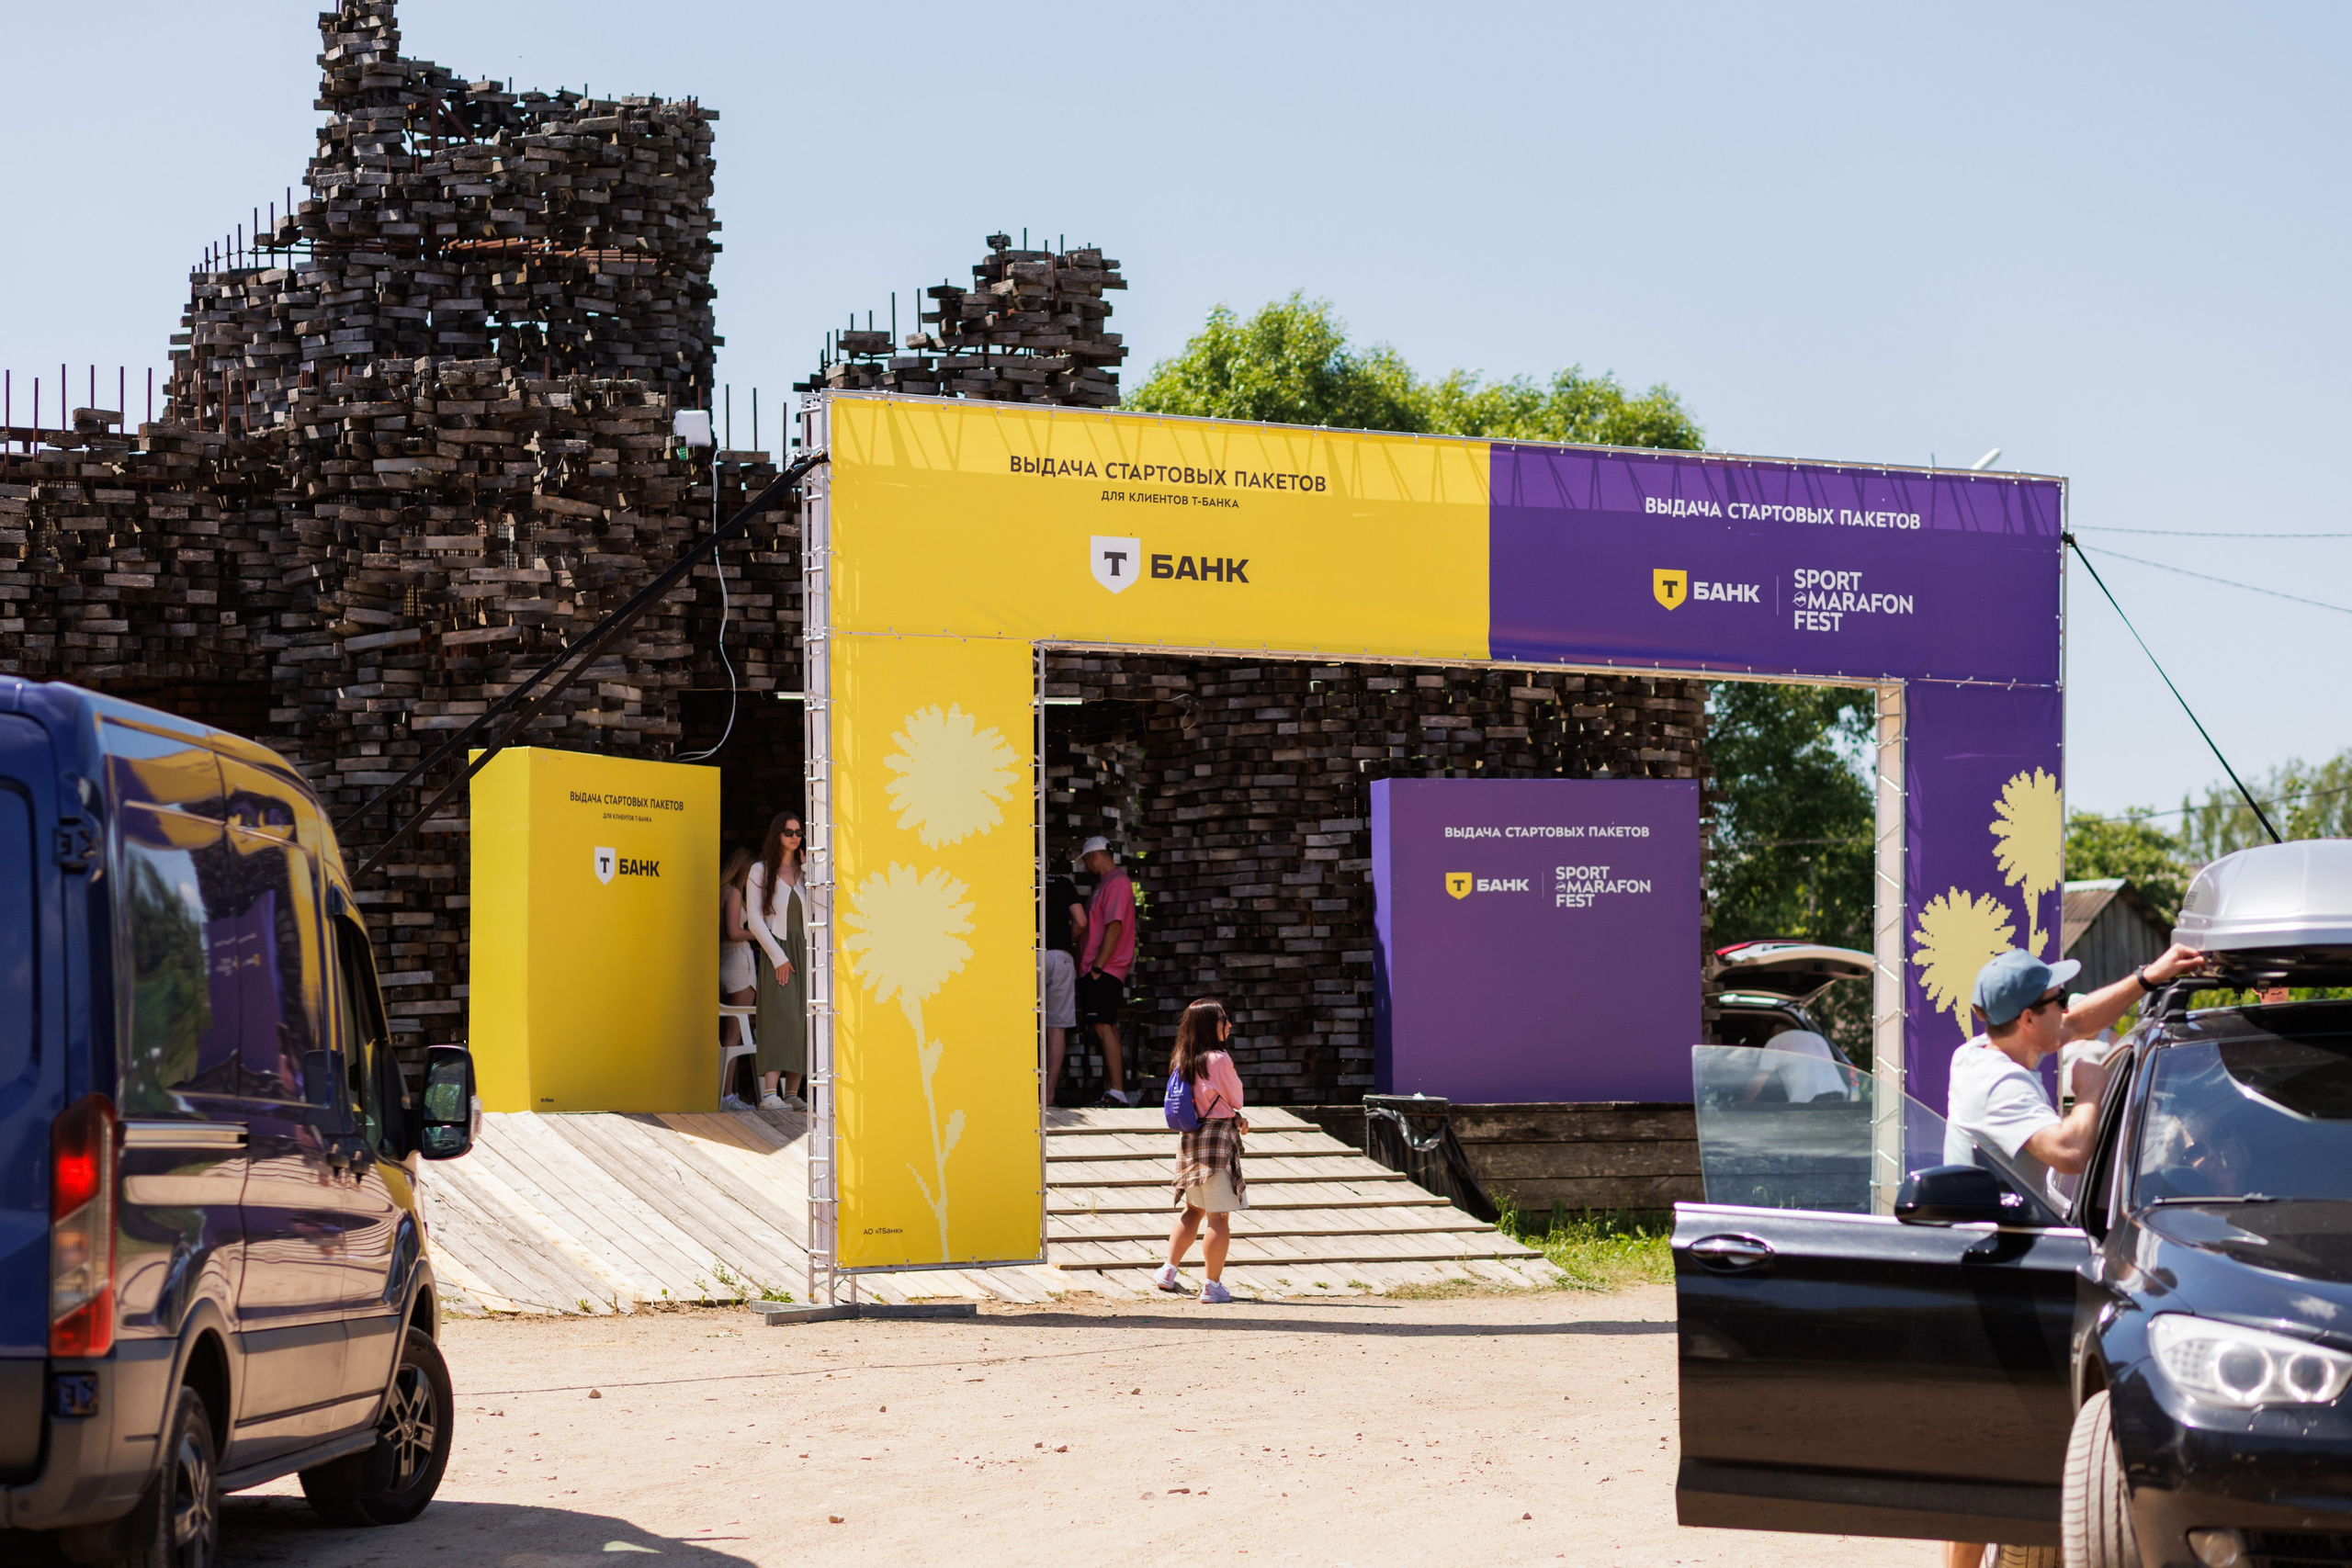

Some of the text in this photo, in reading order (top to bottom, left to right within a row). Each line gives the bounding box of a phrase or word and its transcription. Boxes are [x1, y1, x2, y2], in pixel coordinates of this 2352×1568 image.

[1010, 455, 1327, 492] ВЫДАЧА СТАРТОВЫХ ПАКЕТОВ
[1102, 491, 1239, 508] ДЛЯ КЛИЕНТОВ Т-БАНКА
[1645, 497, 1921, 530] ВЫДАЧА СТАРТОВЫХ ПАКЕТОВ
[1151, 553, 1250, 583] БАНК
[1793, 568, 1862, 592] SPORT
[1693, 581, 1760, 603] БАНК
[1807, 591, 1914, 615] MARAFON
[1794, 610, 1843, 632] FEST
[570, 791, 684, 811] ВЫДАЧА СТАРТОВЫХ ПАКЕТОВ
[613, 813, 634, 821] КЛИЕНТОВ
[1444, 827, 1650, 839] ВЫДАЧА СТАРТОВЫХ ПАКЕТОВ
[619, 858, 660, 877] БАНК
[1555, 865, 1610, 880] SPORT
[1476, 879, 1529, 892] БАНК
[1566, 879, 1651, 893] MARAFON
[1555, 894, 1595, 908] FEST
